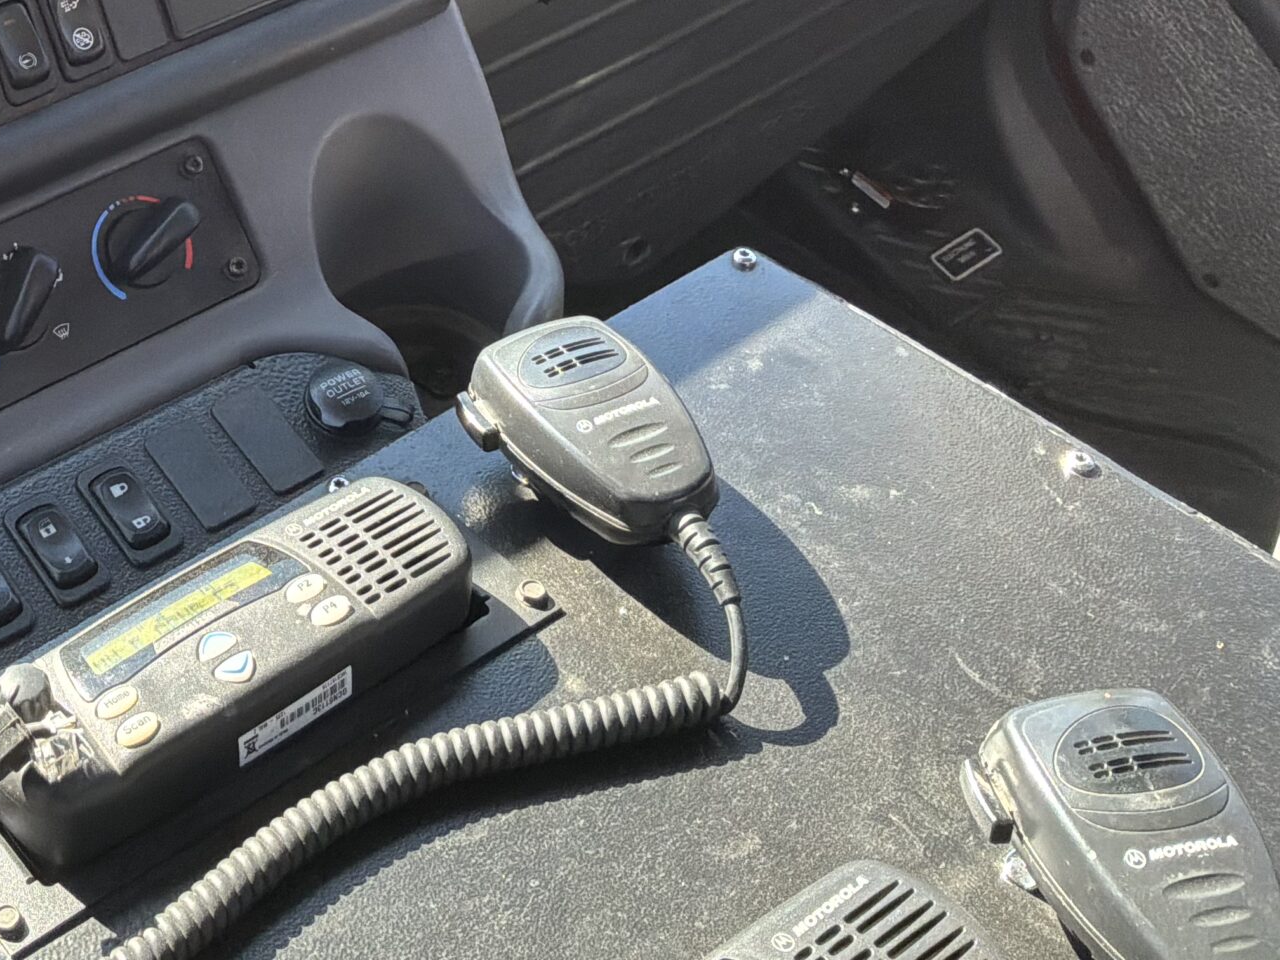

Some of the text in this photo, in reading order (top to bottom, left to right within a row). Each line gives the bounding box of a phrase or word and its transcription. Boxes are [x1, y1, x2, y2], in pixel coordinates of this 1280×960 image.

[320, 368, 361, 390] POWER
[326, 376, 366, 398] OUTLET
[593, 397, 661, 425] MOTOROLA
[304, 486, 370, 527] MOTOROLA
[296, 579, 312, 592] P2
[322, 600, 337, 614] P4
[103, 689, 130, 709] Home
[122, 714, 152, 735] Scan
[1148, 835, 1238, 861] MOTOROLA
[791, 875, 870, 937] MOTOROLA
